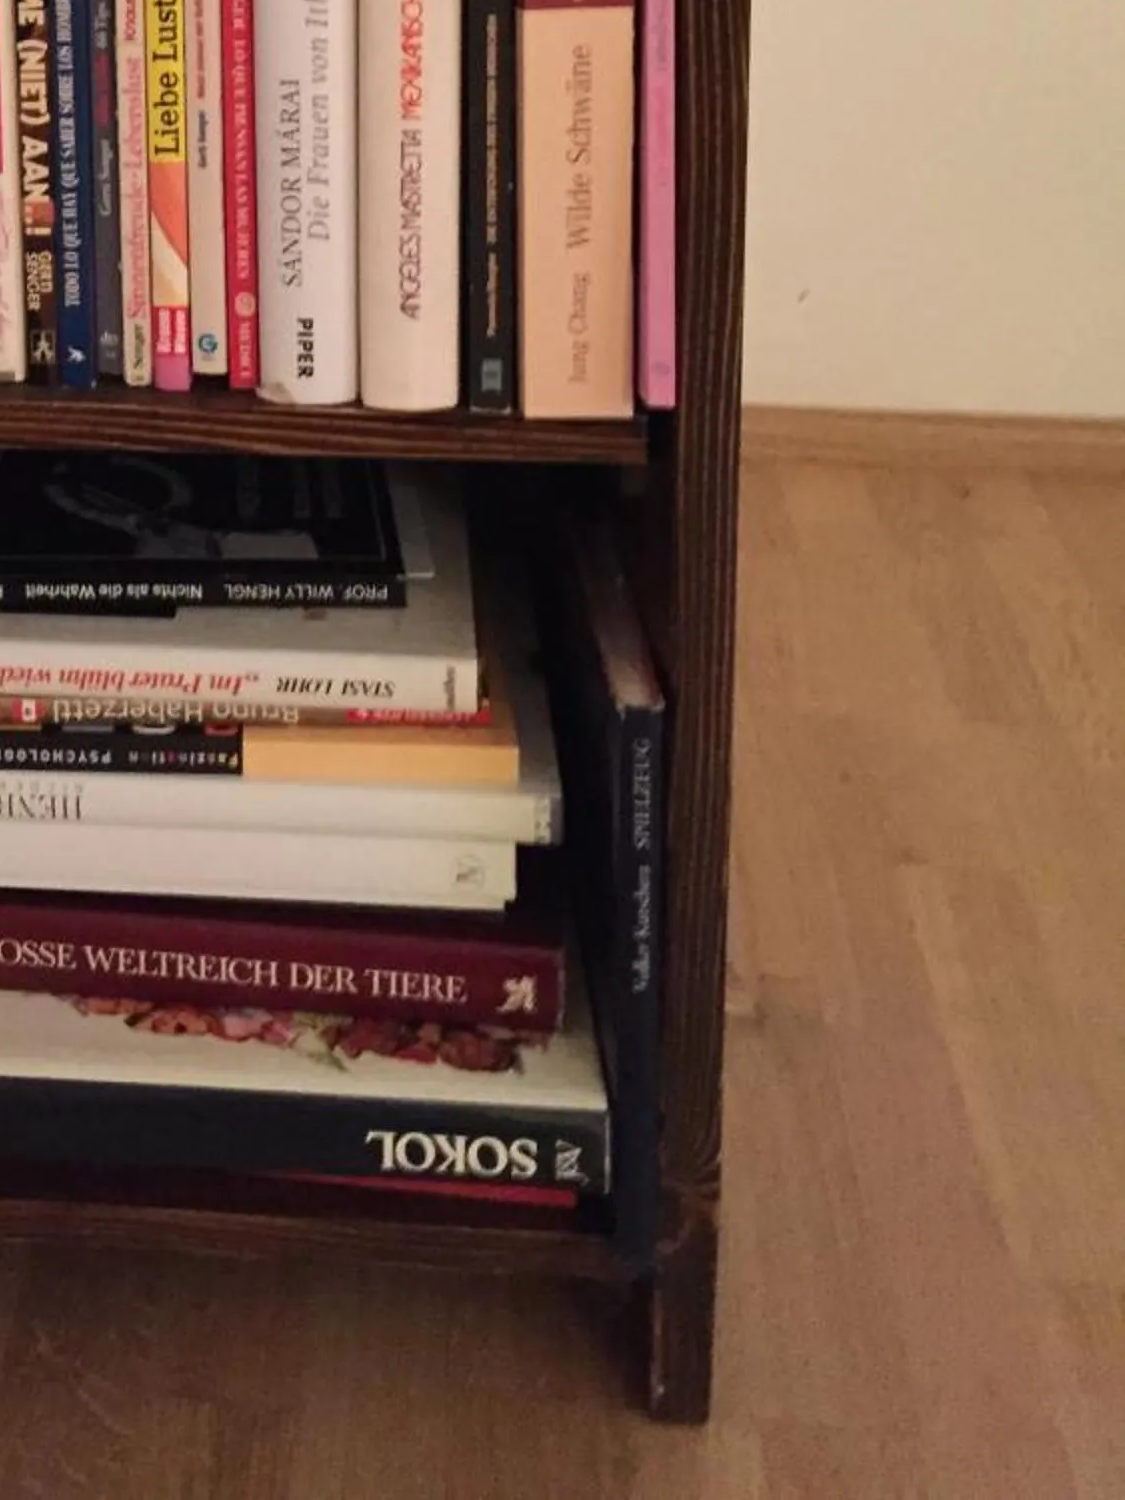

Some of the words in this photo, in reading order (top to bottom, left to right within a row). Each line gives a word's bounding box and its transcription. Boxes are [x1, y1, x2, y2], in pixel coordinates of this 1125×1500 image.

[311, 37, 329, 84] von
[17, 40, 52, 126] (NIET)
[152, 73, 180, 156] Liebe
[564, 43, 593, 166] Schwäne
[305, 93, 331, 187] Frauen
[60, 163, 81, 190] QUE
[306, 194, 331, 243] Die
[564, 171, 592, 255] Wilde
[61, 223, 83, 248] QUE
[62, 273, 81, 308] TODO
[565, 272, 591, 337] Chang
[296, 317, 315, 380] PIPER
[25, 583, 96, 601] Wahrheit
[99, 583, 124, 601] die
[126, 583, 150, 601] als
[153, 582, 204, 601] Nichts
[223, 583, 282, 601] HENGL
[283, 583, 335, 601] WILLY
[340, 583, 389, 601] PROF.
[129, 672, 204, 695] Prater
[53, 698, 204, 725] Haberzettl
[215, 702, 301, 725] Bruno
[80, 944, 278, 988] WELTREICH
[286, 962, 359, 994] DER
[362, 967, 469, 1003] TIERE
[364, 1130, 539, 1181] SOKOL
